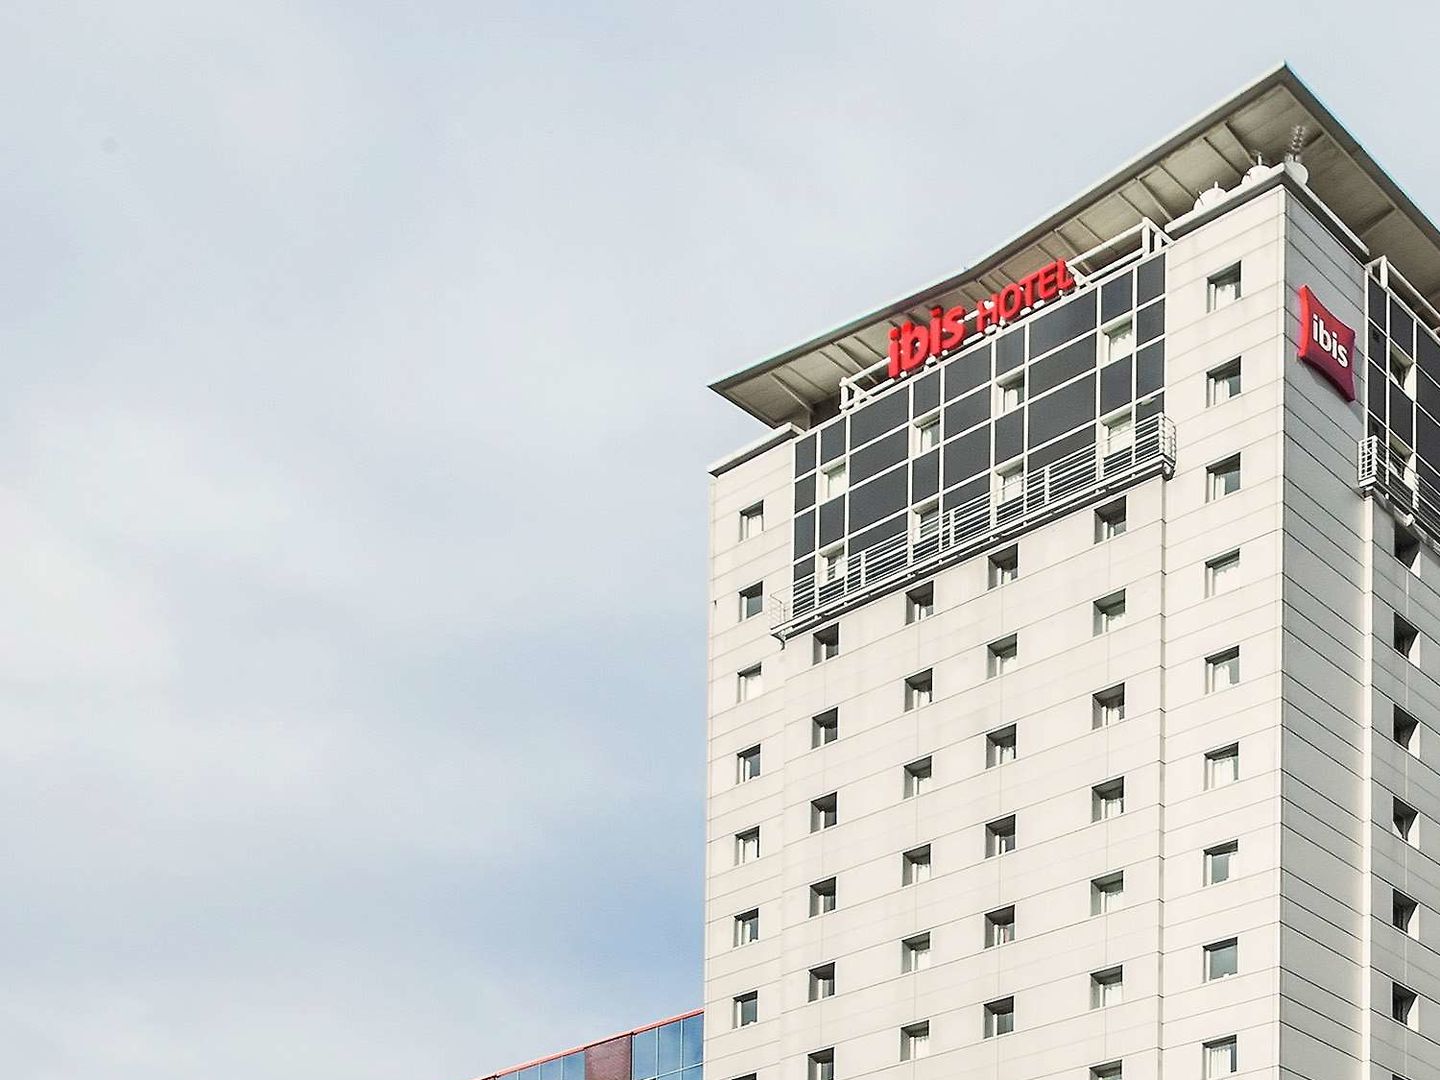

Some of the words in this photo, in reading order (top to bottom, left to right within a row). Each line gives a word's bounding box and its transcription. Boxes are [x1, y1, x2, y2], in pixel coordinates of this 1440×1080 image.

[887, 304, 968, 379] ibis
[976, 258, 1075, 334] HOTEL
[1312, 313, 1350, 369] ibis
